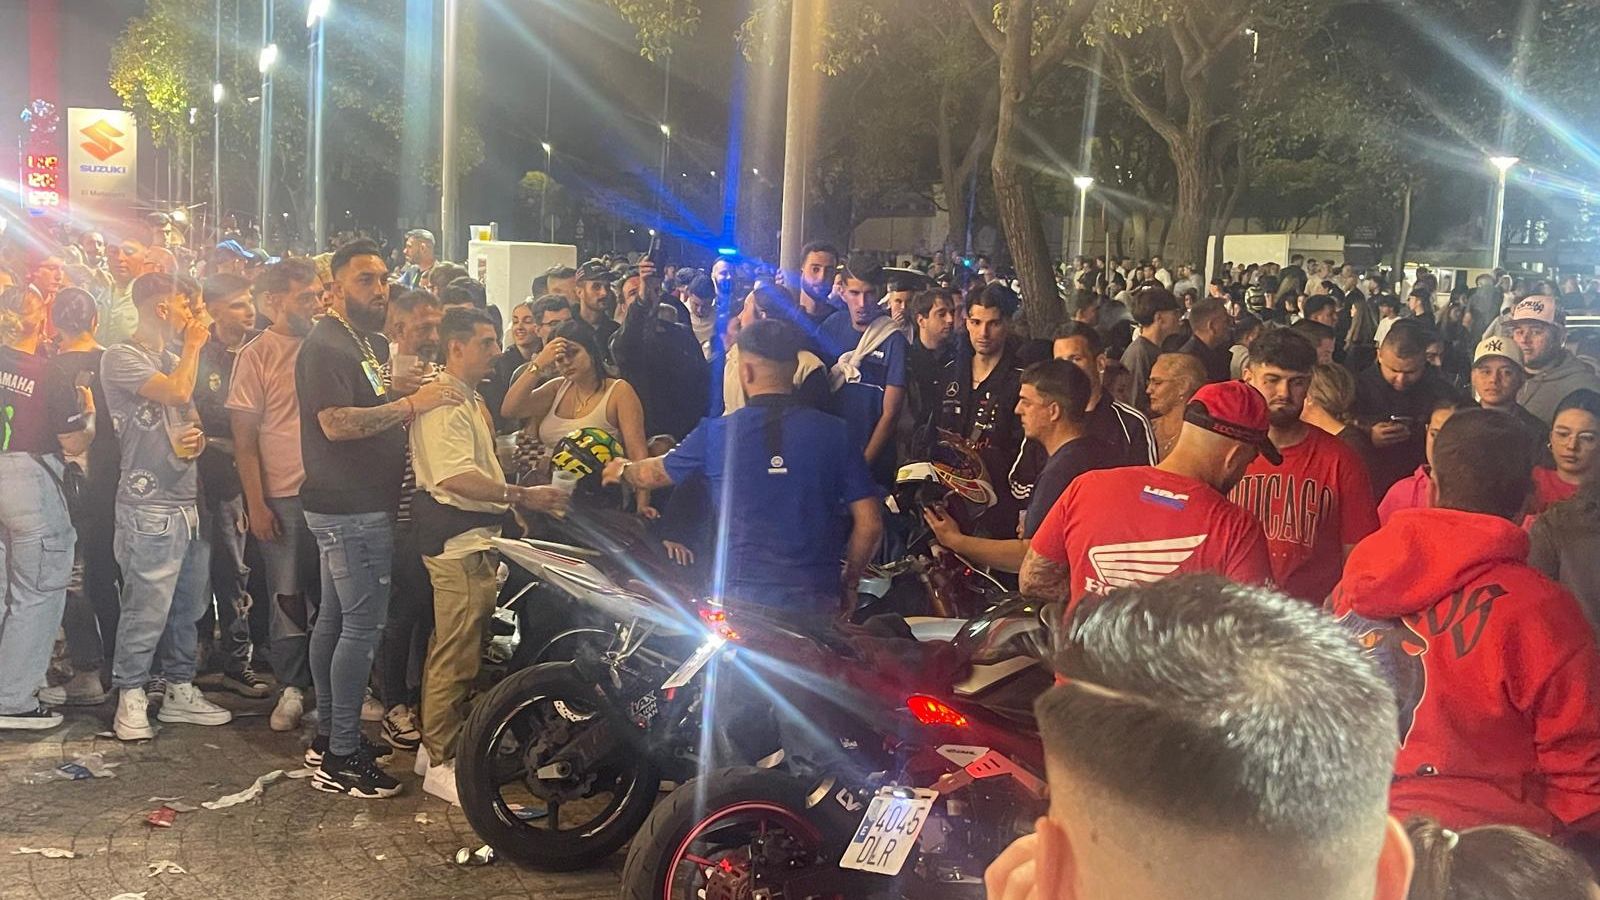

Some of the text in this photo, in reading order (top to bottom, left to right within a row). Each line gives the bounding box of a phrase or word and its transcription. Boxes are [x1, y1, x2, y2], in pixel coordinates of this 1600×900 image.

[80, 164, 126, 174] SUZUKI
[0, 371, 35, 395] MAHA
[860, 825, 869, 836] E
[876, 804, 925, 835] 4045
[855, 836, 897, 867] DLR
